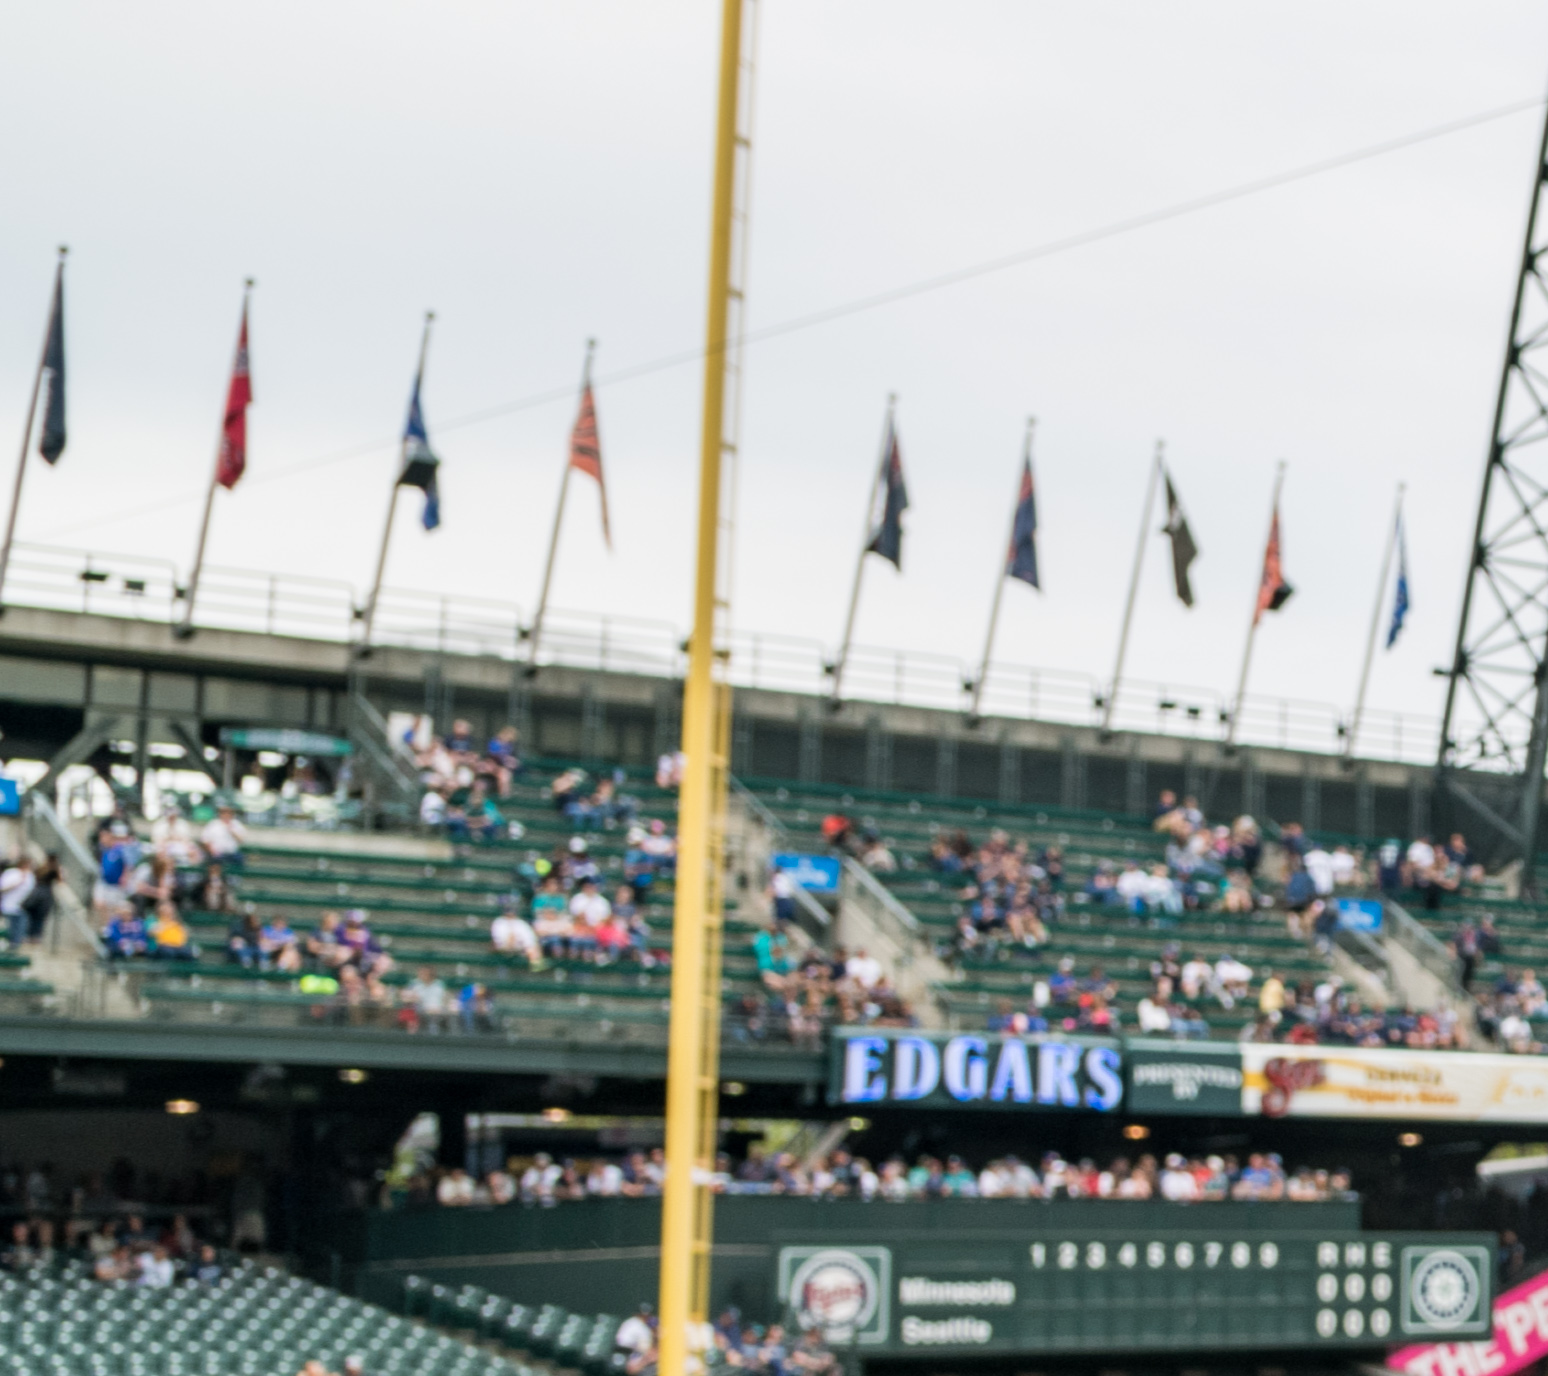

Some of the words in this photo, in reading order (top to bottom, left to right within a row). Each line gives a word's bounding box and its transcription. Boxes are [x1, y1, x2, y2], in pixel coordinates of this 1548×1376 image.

[843, 1035, 1123, 1112] EDGAR'S
[1031, 1241, 1046, 1268] 1
[1058, 1241, 1078, 1268] 2
[1086, 1241, 1106, 1268] 3
[1118, 1241, 1137, 1268] 4
[1147, 1241, 1165, 1268] 5
[1175, 1241, 1194, 1268] 6
[1204, 1241, 1222, 1268] 7
[1231, 1241, 1250, 1268] 8
[1260, 1241, 1279, 1268] 9
[1317, 1241, 1339, 1268] R
[1372, 1241, 1392, 1268] E
[900, 1277, 1015, 1305] Minnesota
[902, 1316, 992, 1344] Seattle
